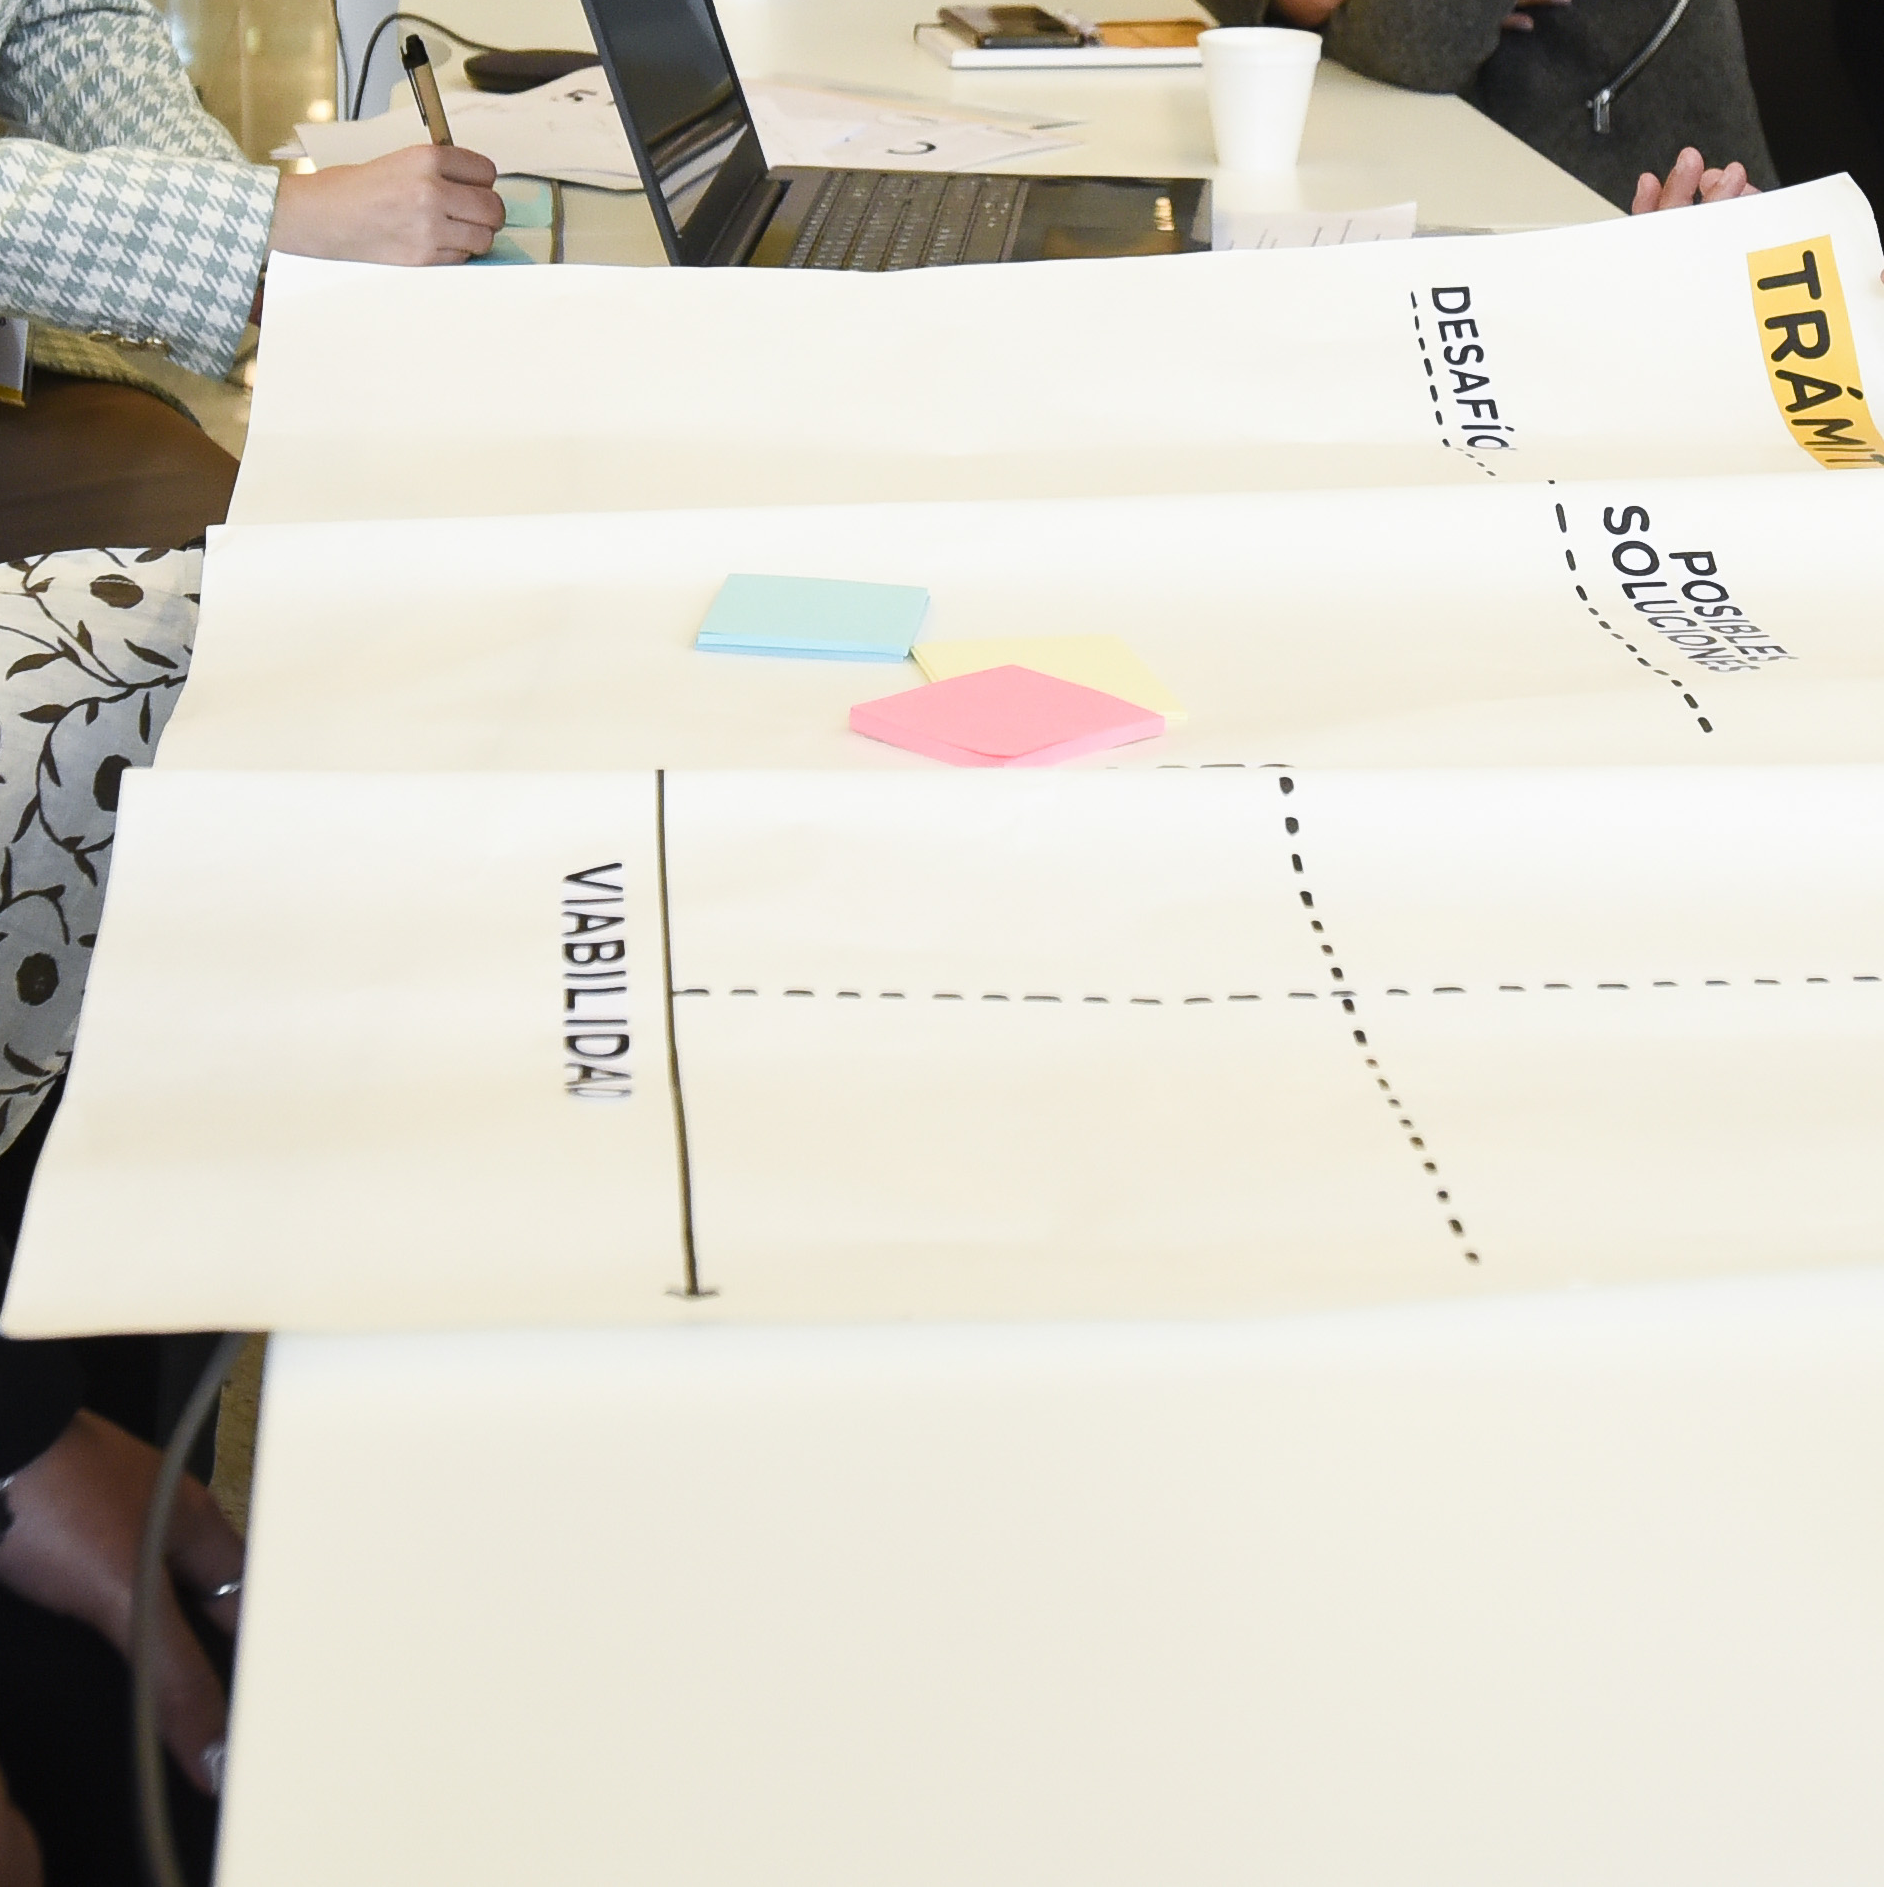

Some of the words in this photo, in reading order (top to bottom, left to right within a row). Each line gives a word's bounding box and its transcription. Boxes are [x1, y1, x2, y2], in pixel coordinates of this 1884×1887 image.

[1431, 286, 1517, 451] DESAFÍO
[1603, 505, 1761, 673] SOLUCIONES
[1669, 551, 1800, 661] POSIBLES
